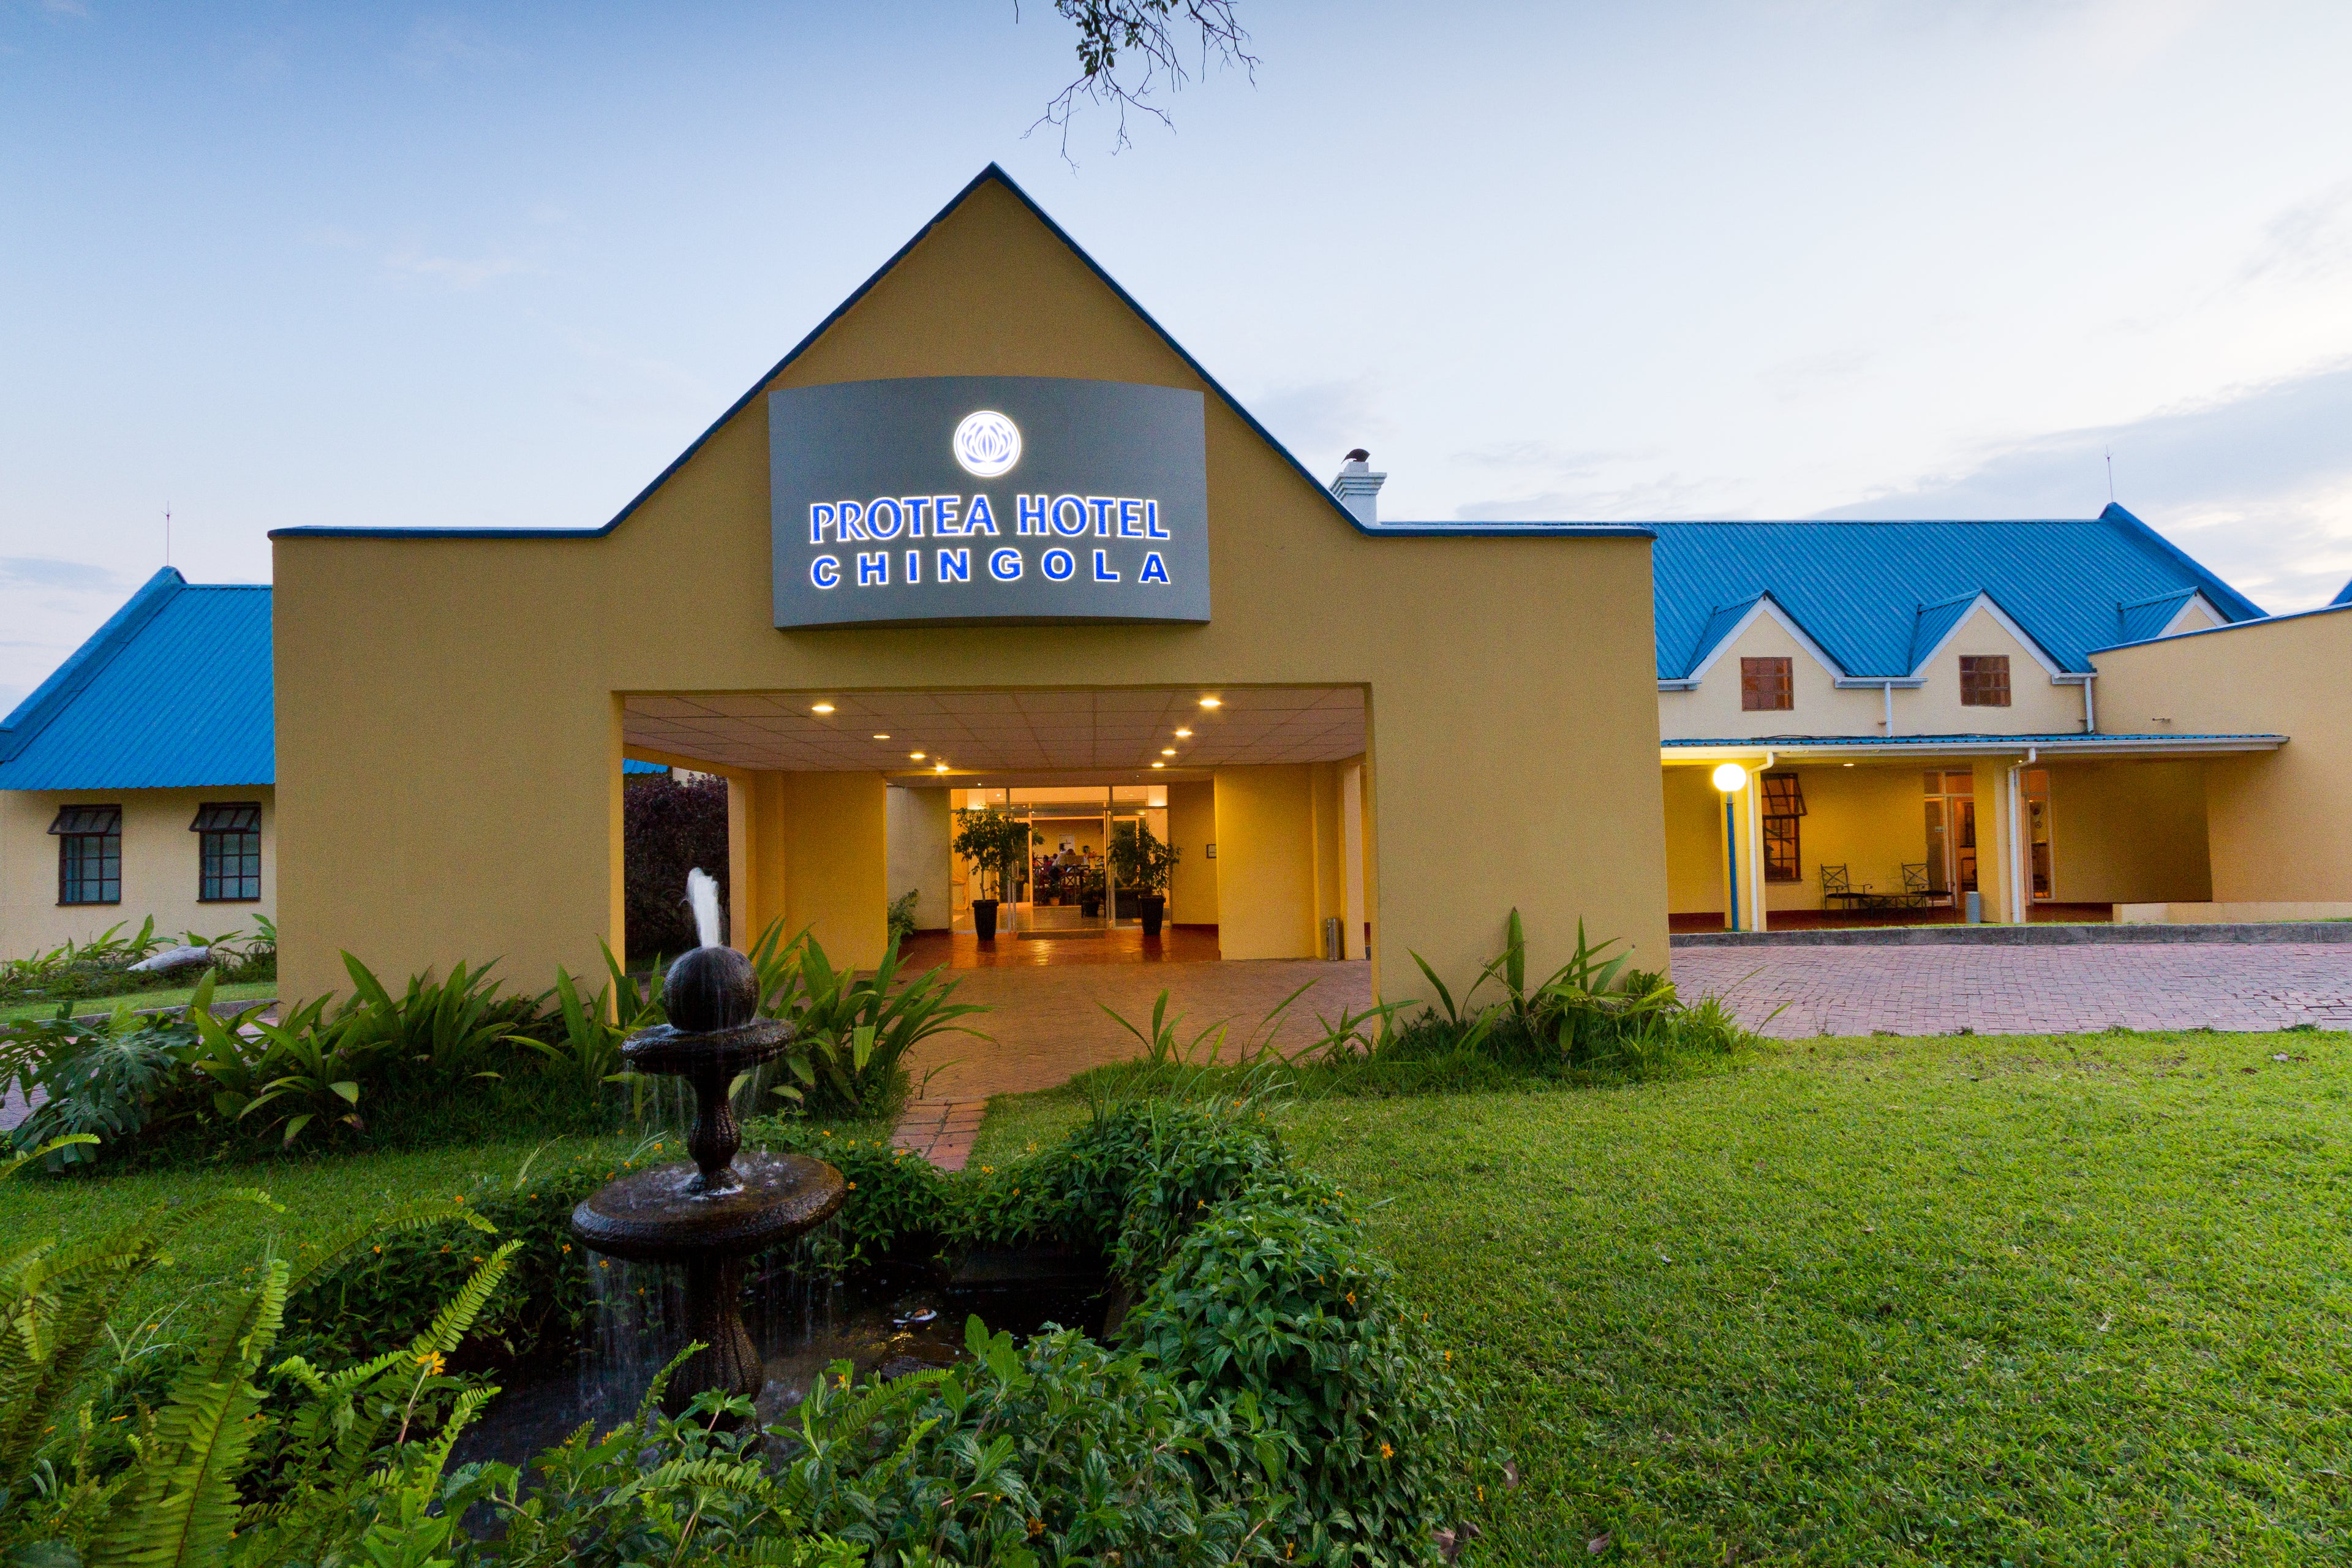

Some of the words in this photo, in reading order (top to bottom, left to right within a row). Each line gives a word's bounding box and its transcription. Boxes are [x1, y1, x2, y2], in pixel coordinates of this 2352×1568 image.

[809, 494, 1000, 545] PROTEA
[1016, 494, 1171, 540] HOTEL
[810, 547, 1171, 589] CHINGOLA
